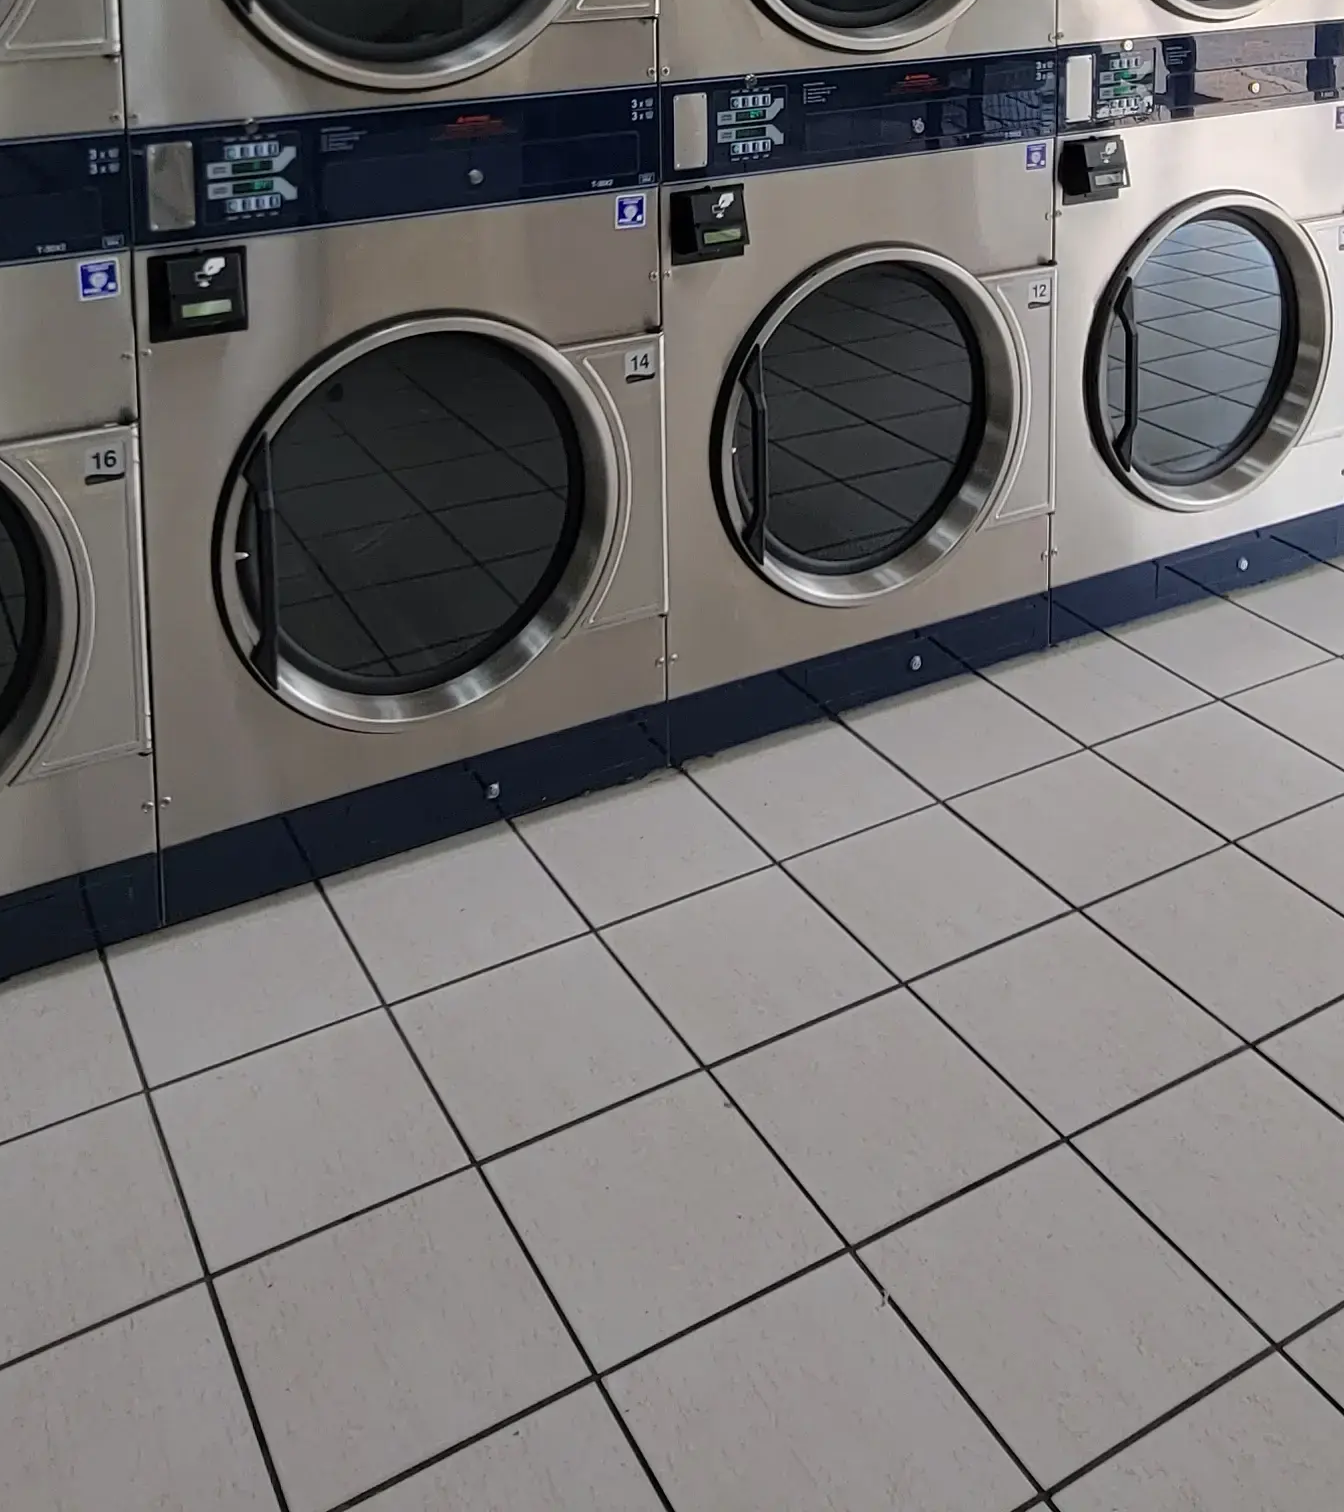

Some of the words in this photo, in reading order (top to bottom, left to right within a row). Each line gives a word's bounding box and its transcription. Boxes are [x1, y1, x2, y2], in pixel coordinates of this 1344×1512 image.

[1032, 284, 1047, 298] 12
[630, 353, 650, 372] 14
[91, 449, 117, 470] 16
